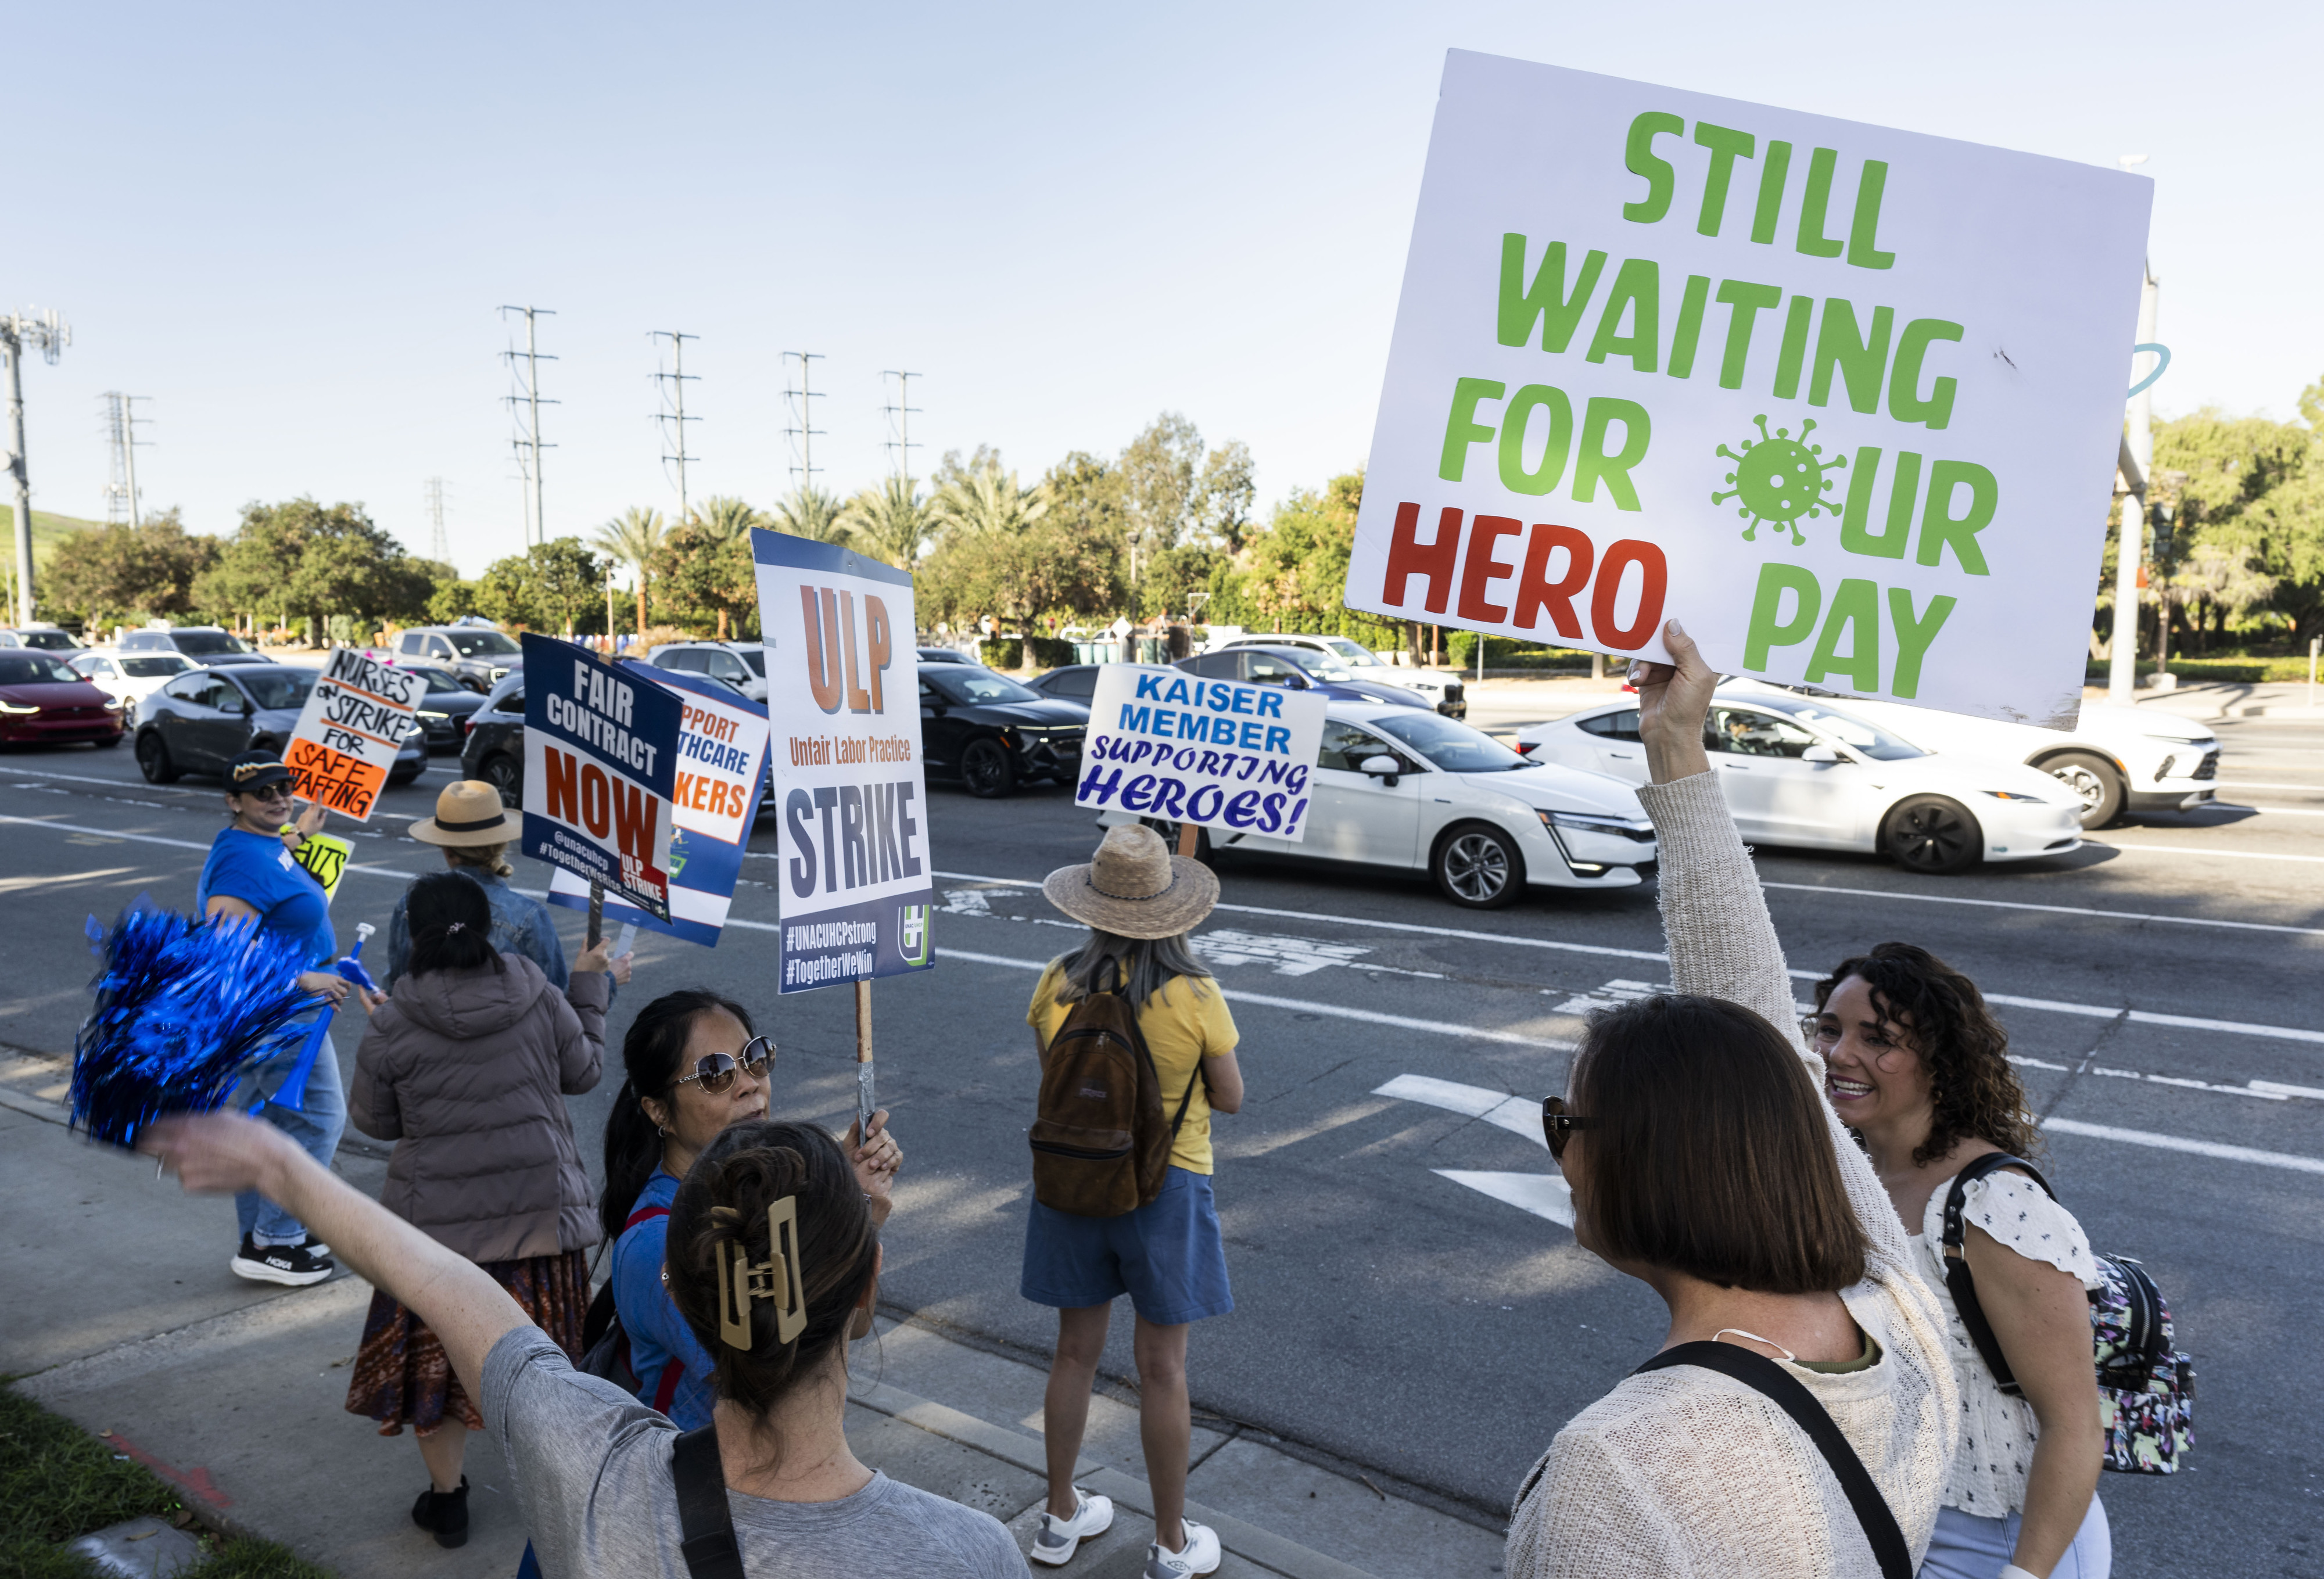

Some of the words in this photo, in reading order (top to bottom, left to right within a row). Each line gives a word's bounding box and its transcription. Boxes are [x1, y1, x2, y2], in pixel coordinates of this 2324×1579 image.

[1622, 111, 1896, 270] STILL
[1497, 232, 1964, 430] WAITING
[1439, 376, 1652, 512] FOR
[1382, 501, 1667, 651] HERO
[1742, 562, 1958, 699] PAY
[800, 584, 891, 715] ULP
[317, 685, 339, 700] ON
[329, 649, 414, 704] NURSES
[574, 659, 634, 729] FAIR
[1135, 674, 1284, 719] KAISER
[322, 728, 364, 755] FOR
[326, 695, 411, 744] STRIKE
[547, 693, 657, 777] CONTRACT
[680, 704, 740, 744] PPORT
[1118, 704, 1292, 755] MEMBER
[295, 744, 374, 787] SAFE
[677, 730, 750, 776] THCARE
[790, 735, 831, 766] Unfair
[834, 735, 866, 765] Labor
[869, 734, 911, 764] Practice
[1091, 735, 1308, 796] SUPPORTING
[544, 745, 659, 865] NOW
[673, 770, 746, 819] KERS
[1077, 765, 1308, 835] HEROES!
[554, 830, 609, 871] @unacuhcp
[786, 781, 922, 898] STRIKE
[539, 842, 622, 893] #TogetherWeRise
[621, 853, 644, 877] ULP
[622, 871, 664, 903] STRIKE
[786, 920, 877, 952] #UNACUHCPstrong
[786, 949, 873, 985] #TogetherWeWin
